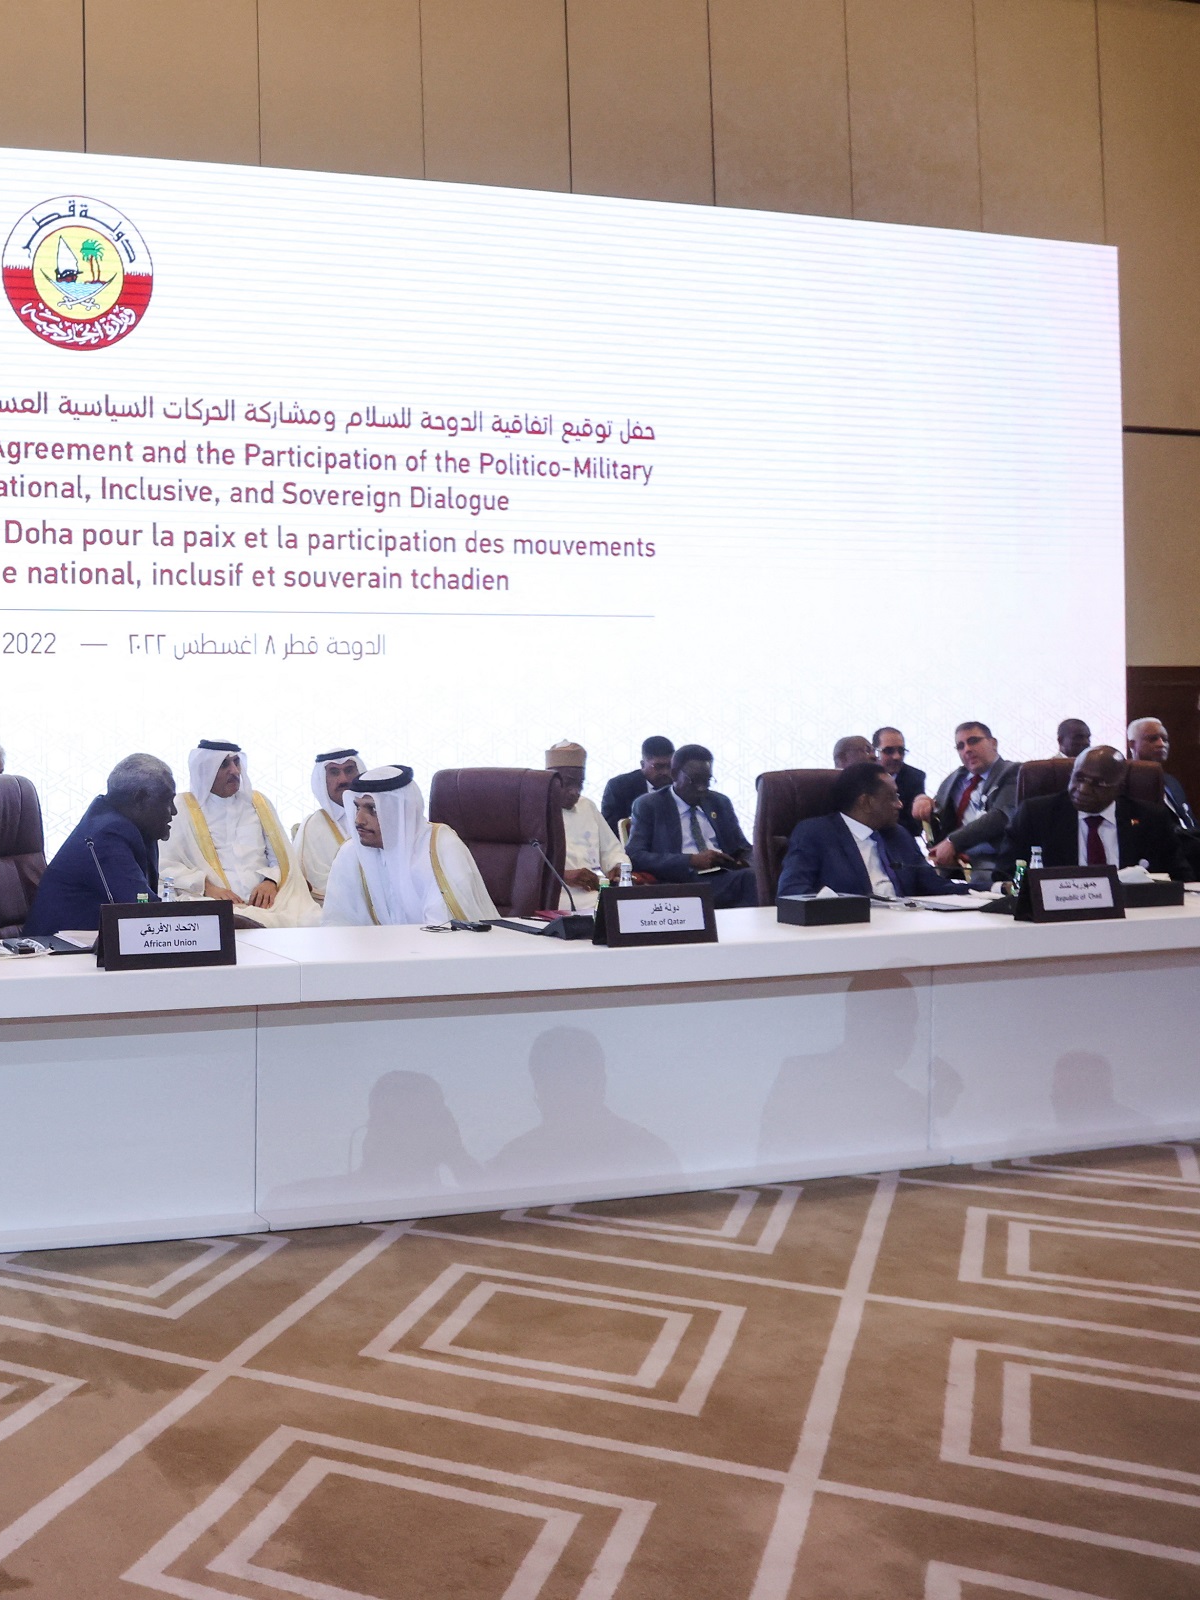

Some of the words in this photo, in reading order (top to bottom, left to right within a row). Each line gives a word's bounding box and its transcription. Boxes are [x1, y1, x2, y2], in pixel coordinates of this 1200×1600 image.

[58, 394, 154, 422] السياسية
[163, 397, 235, 427] الحركات
[244, 401, 336, 432] ومشاركة
[345, 405, 411, 434] للسلام
[420, 410, 483, 437] الدوحة
[491, 413, 553, 439] اتفاقية
[561, 418, 613, 444] توقيع
[619, 418, 656, 445] حفل
[142, 439, 187, 464] and
[196, 440, 236, 466] the
[245, 443, 397, 475] Participation
[405, 449, 427, 472] of
[434, 450, 471, 474] the
[479, 452, 653, 486] Politico-Military
[101, 476, 220, 506] Inclusive,
[230, 480, 274, 504] and
[282, 481, 401, 512] Sovereign
[410, 486, 509, 514] Dialogue
[4, 519, 73, 545] Doha
[82, 528, 143, 552] pour
[152, 522, 174, 547] la
[183, 524, 236, 554] paix
[244, 528, 268, 549] et
[277, 525, 298, 549] la
[308, 527, 456, 558] participation
[465, 530, 505, 554] des
[513, 537, 656, 558] mouvements
[28, 560, 141, 589] national,
[152, 561, 243, 587] inclusif
[252, 566, 275, 587] et
[283, 566, 402, 589] souverain
[410, 566, 509, 591] tchadien
[2, 632, 56, 655] 2022
[173, 632, 257, 661] اغسطس
[282, 633, 319, 661] قطر
[326, 633, 386, 661] الدوحة
[651, 903, 663, 914] قطر
[659, 918, 666, 926] of
[667, 918, 686, 926] Qatar
[665, 903, 680, 913] دولة
[143, 940, 172, 948] African
[173, 939, 198, 947] Union
